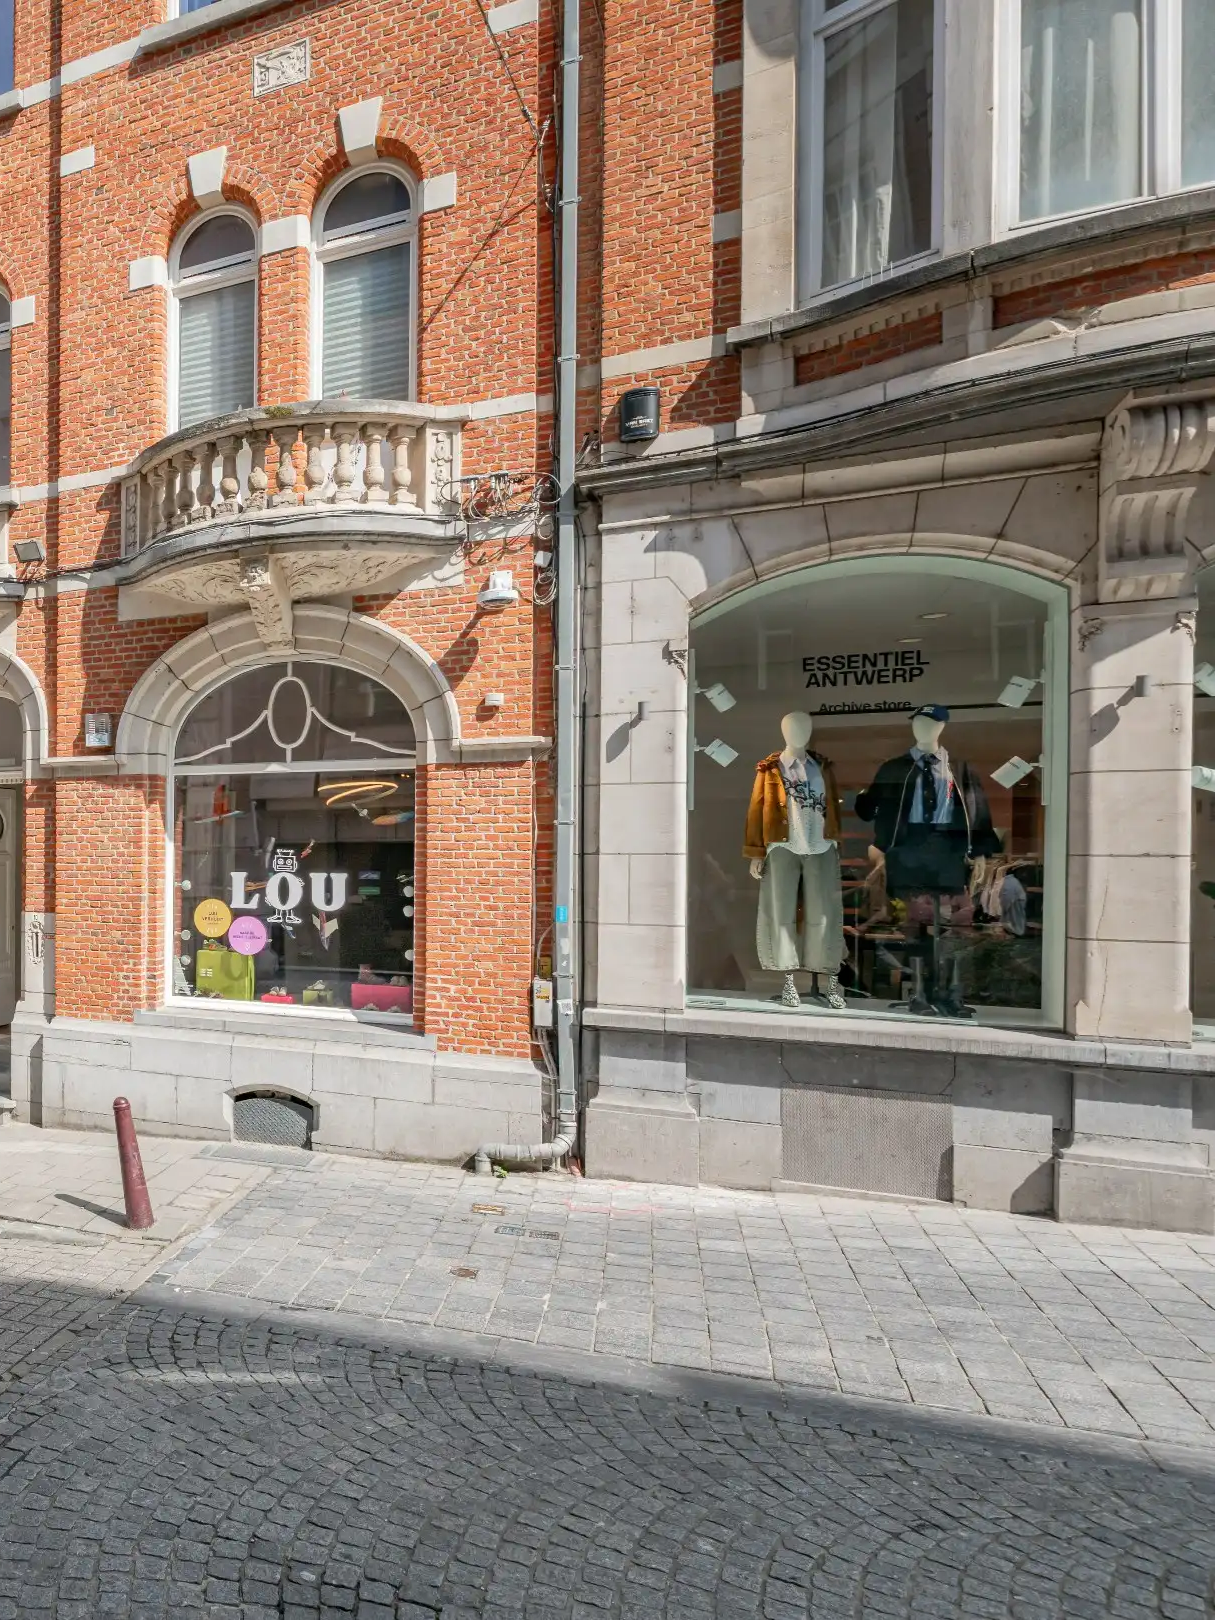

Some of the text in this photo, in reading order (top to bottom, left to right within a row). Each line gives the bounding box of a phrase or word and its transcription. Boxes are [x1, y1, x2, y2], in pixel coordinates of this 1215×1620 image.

[802, 650, 930, 672] ESSENTIEL
[805, 666, 925, 688] ANTWERP
[819, 701, 874, 713] Archive
[875, 700, 912, 711] store
[230, 871, 349, 912] LOU
